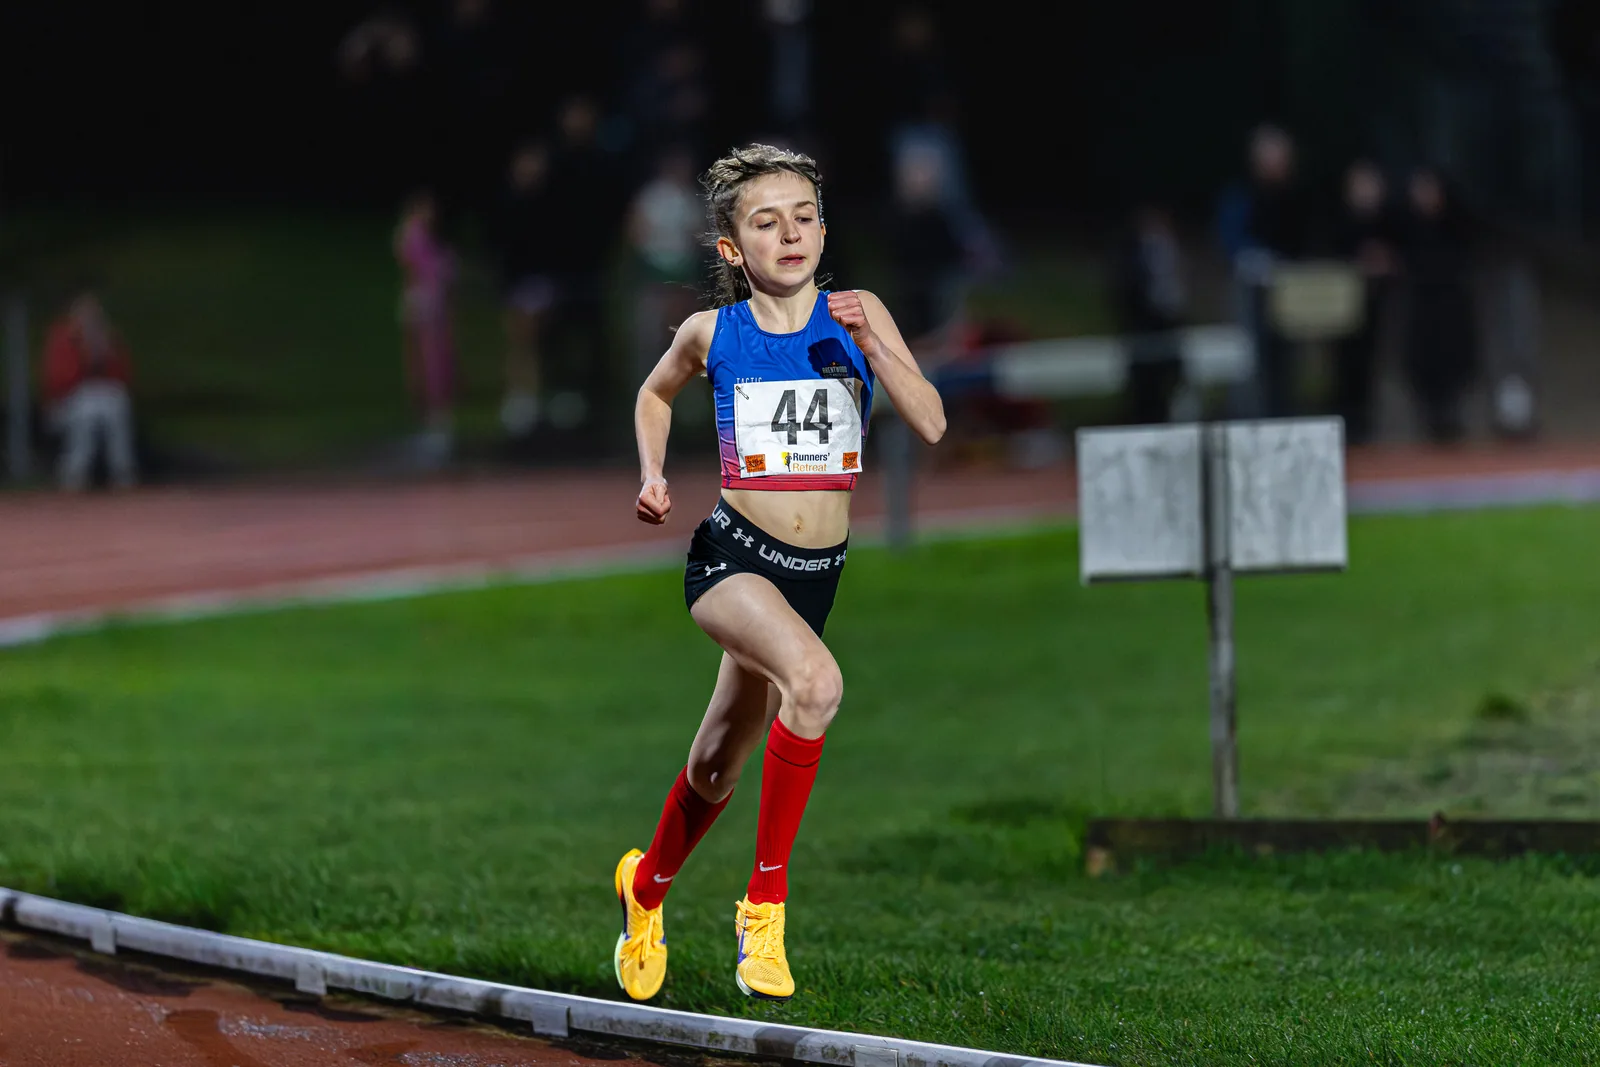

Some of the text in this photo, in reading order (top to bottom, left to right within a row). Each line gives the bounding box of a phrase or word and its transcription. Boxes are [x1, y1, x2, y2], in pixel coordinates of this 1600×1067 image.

[771, 389, 832, 445] 44
[793, 463, 827, 471] Retreat
[758, 544, 831, 571] UNDER
